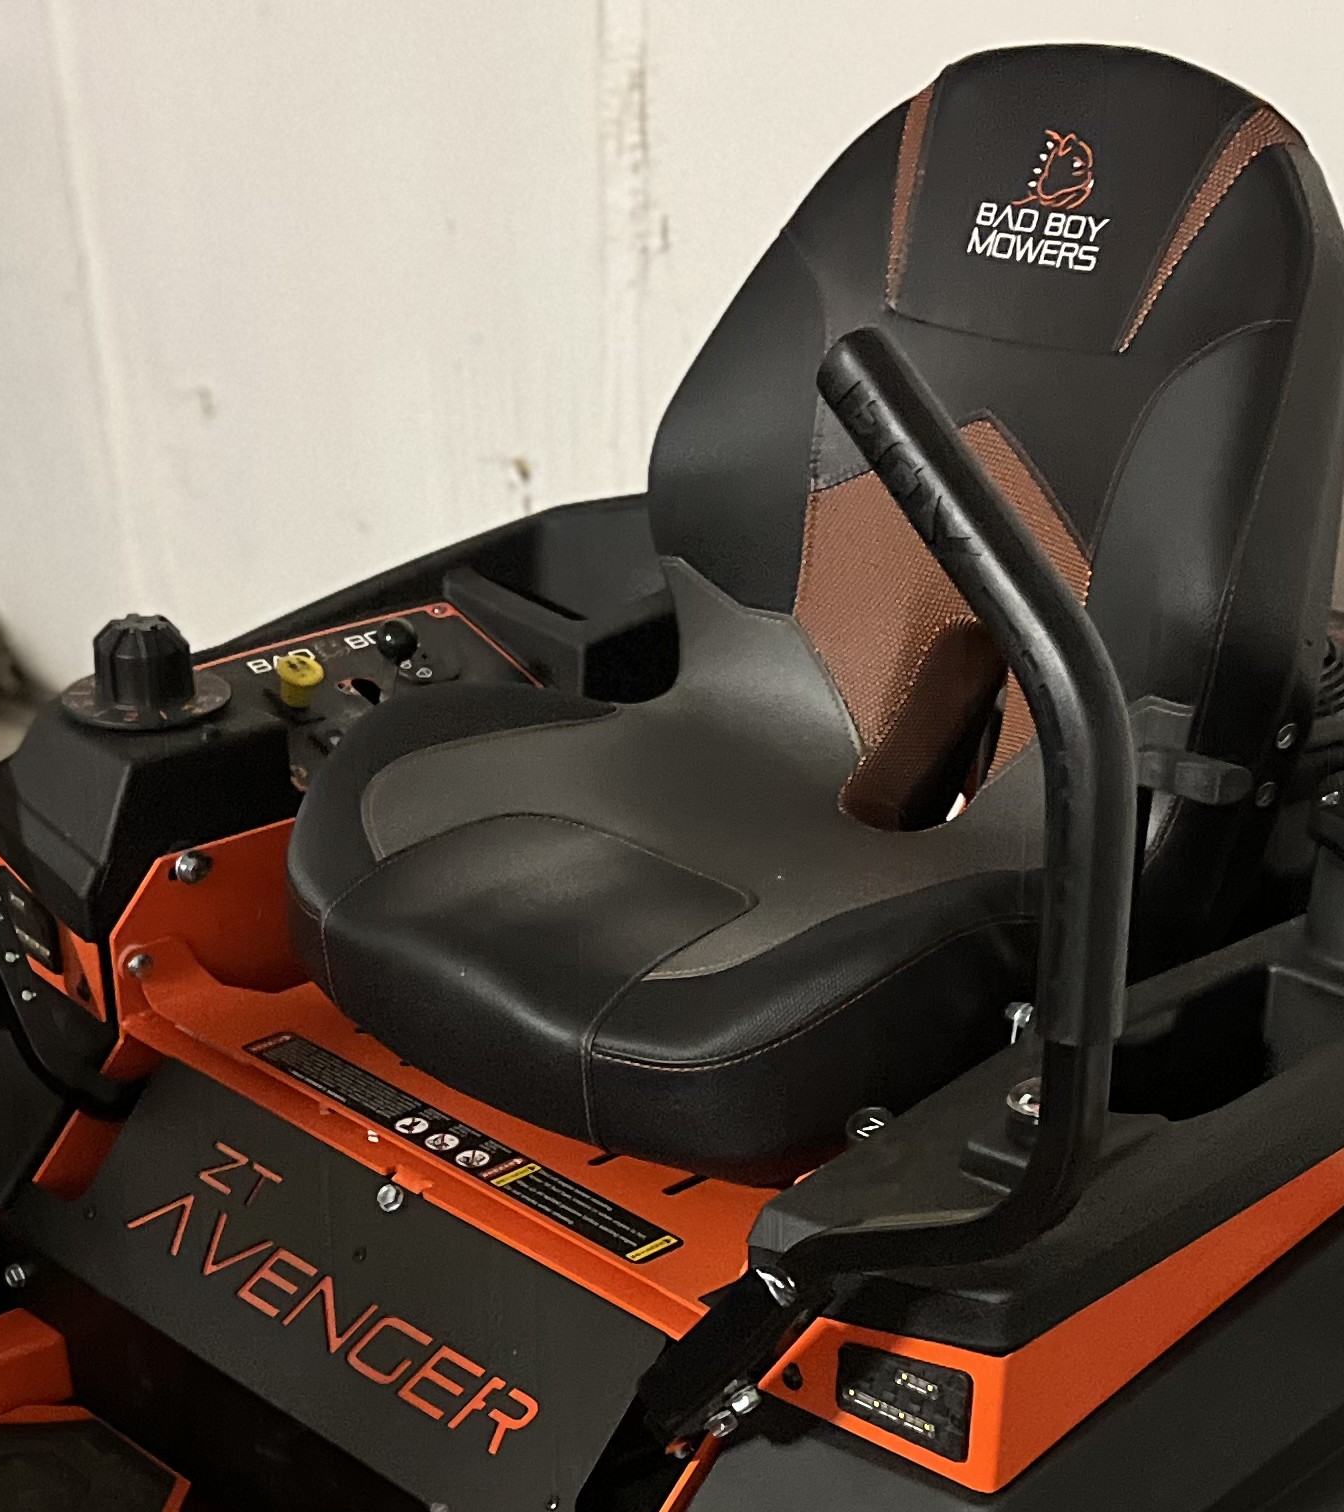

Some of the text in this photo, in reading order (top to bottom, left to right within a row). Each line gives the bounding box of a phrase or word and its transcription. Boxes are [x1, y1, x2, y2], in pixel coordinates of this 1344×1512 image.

[967, 226, 1099, 272] MOWERS
[976, 202, 1110, 242] BAD BOY
[198, 1141, 284, 1205] ZT
[126, 1193, 541, 1456] AVENGER
